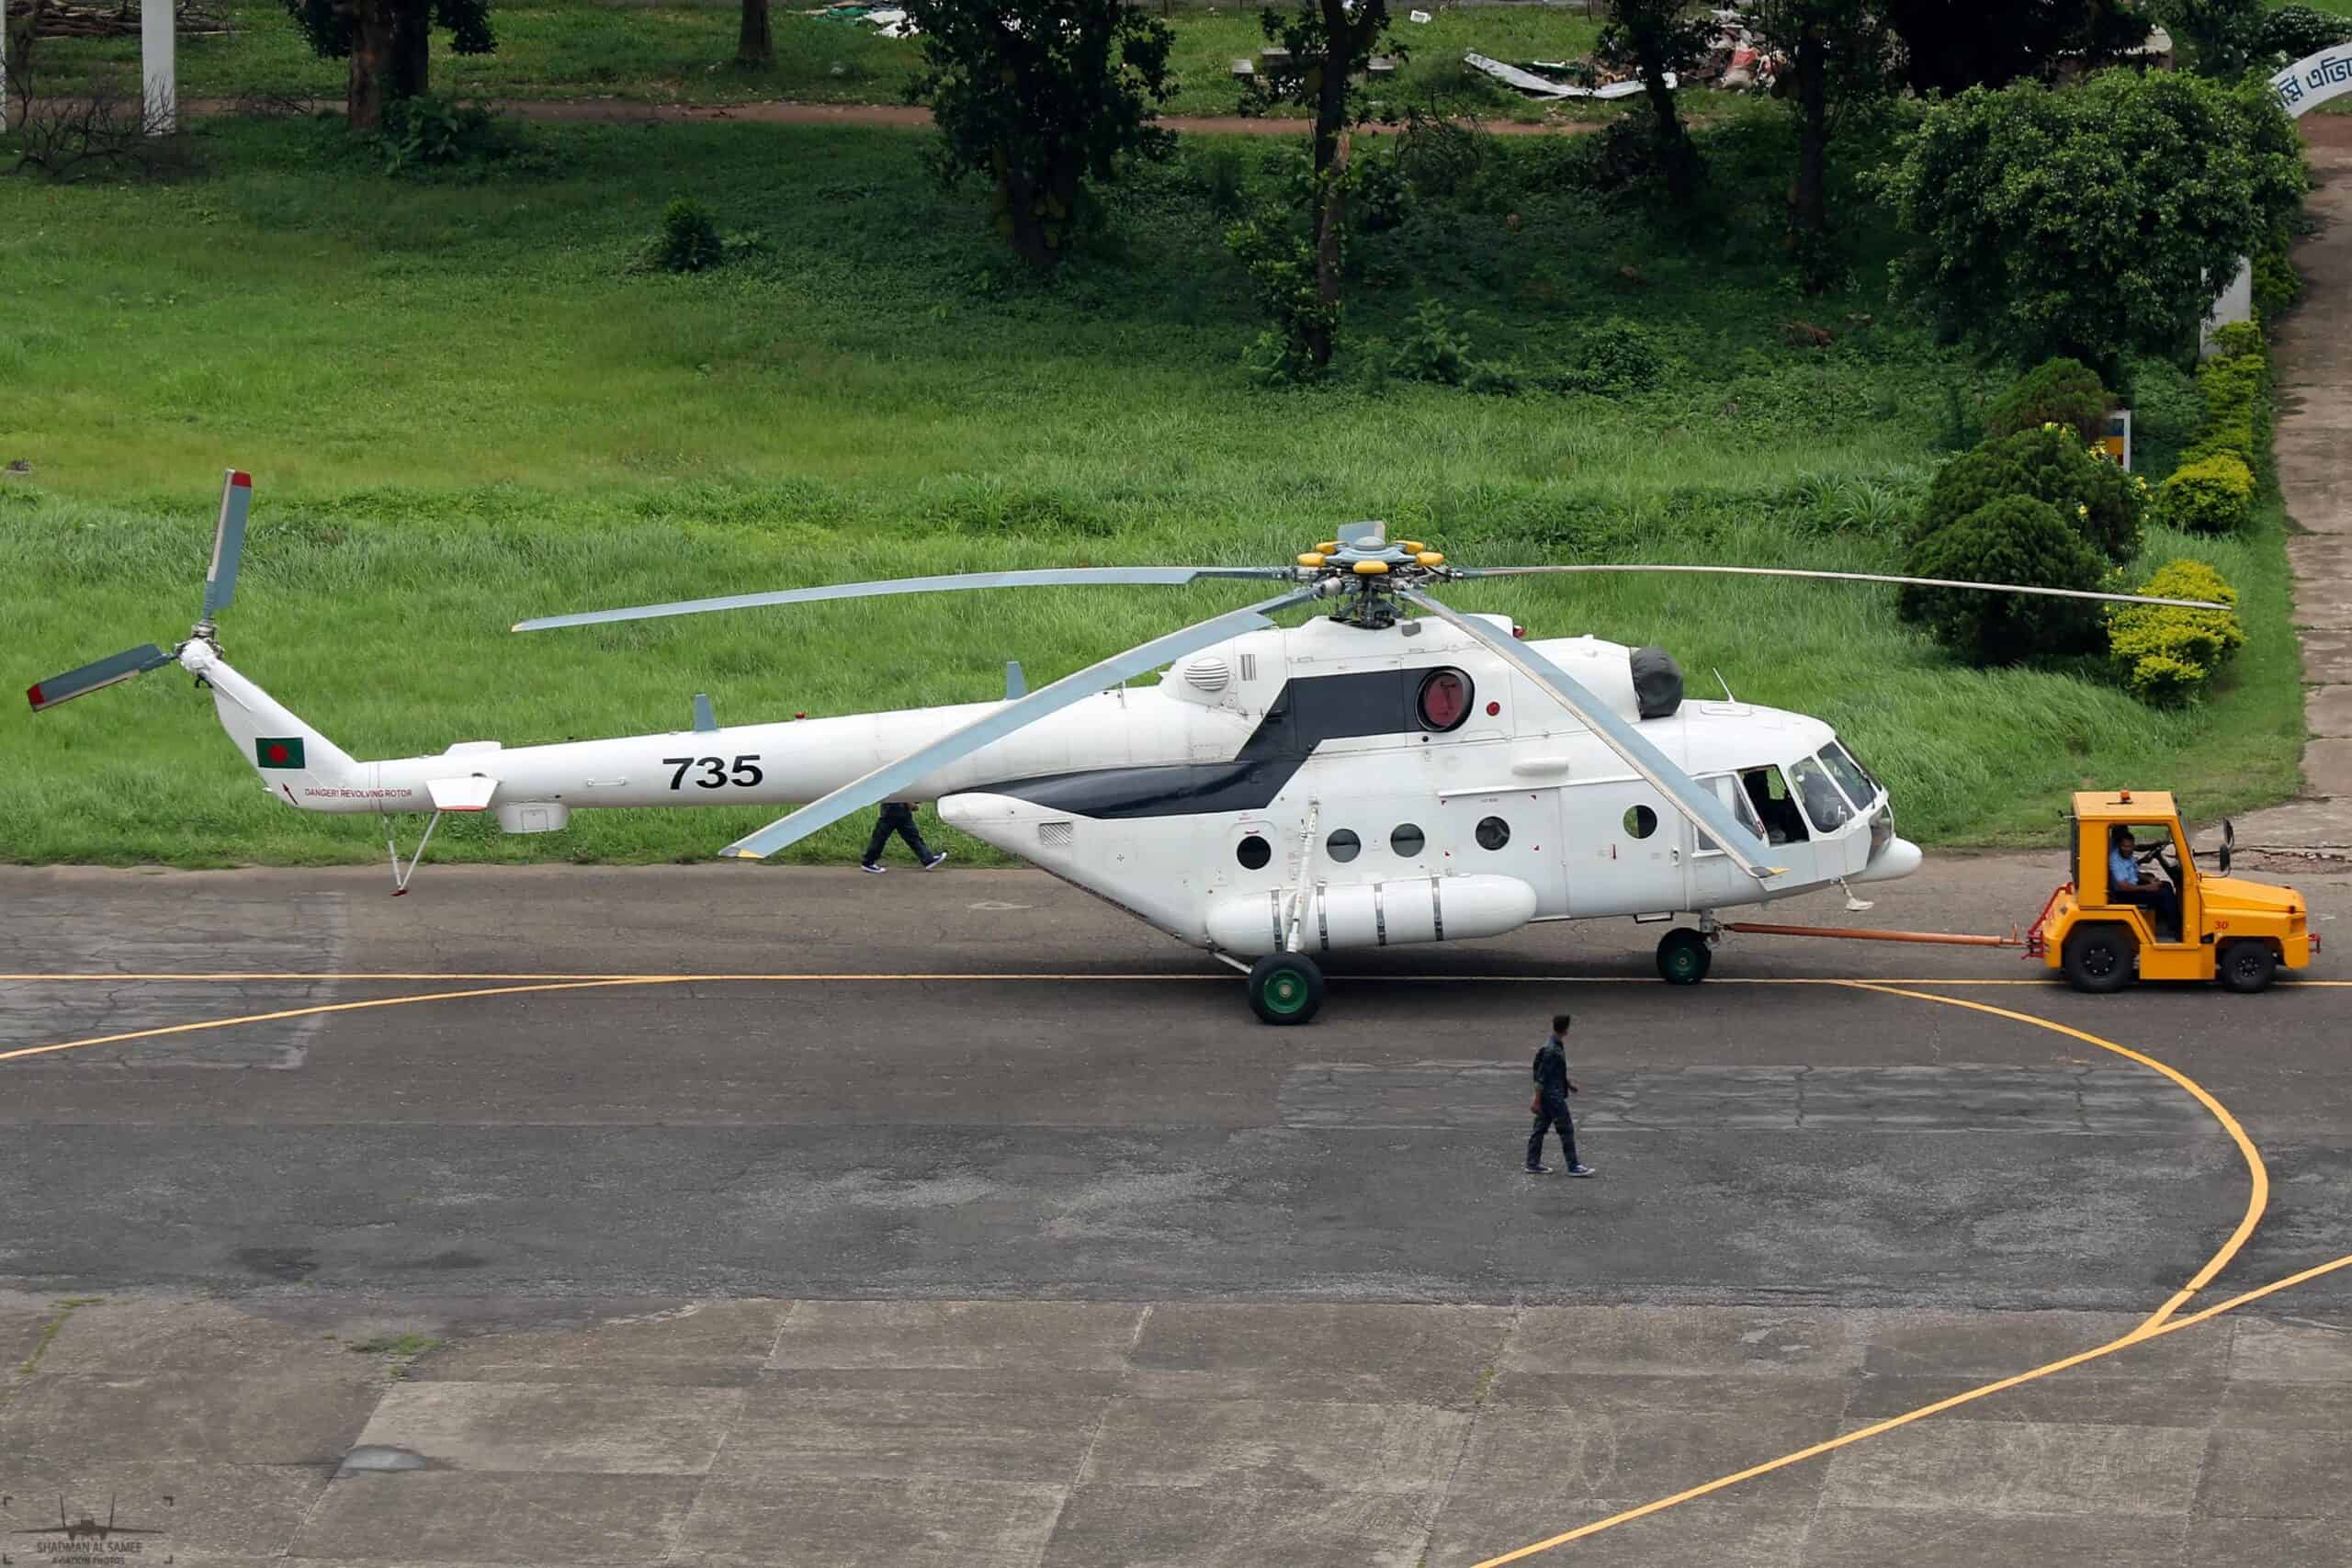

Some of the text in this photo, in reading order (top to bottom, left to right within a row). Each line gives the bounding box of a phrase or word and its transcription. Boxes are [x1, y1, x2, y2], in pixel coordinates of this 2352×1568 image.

[2305, 56, 2352, 89] এভি
[662, 755, 763, 790] 735
[340, 789, 384, 798] REVOLVING
[385, 789, 413, 797] ROTOR
[2214, 919, 2229, 931] 30
